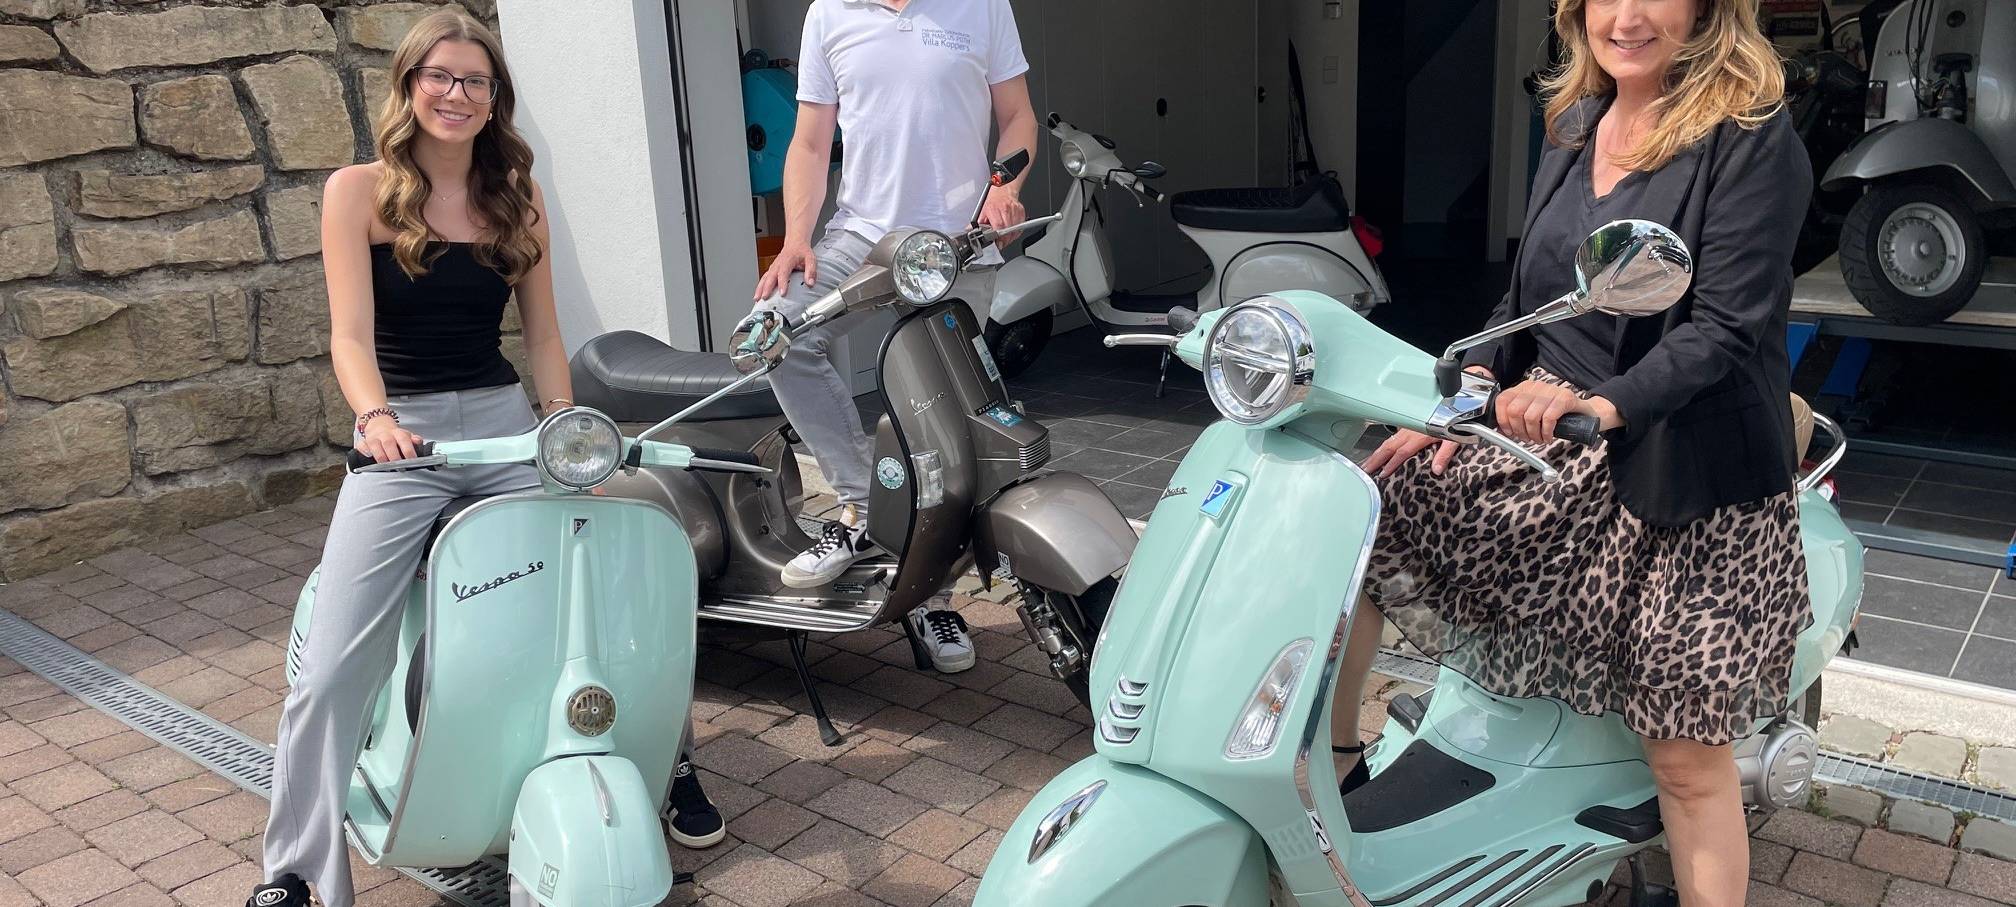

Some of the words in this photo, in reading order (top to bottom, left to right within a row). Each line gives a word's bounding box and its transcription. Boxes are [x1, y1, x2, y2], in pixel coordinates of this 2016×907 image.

[922, 38, 940, 47] Villa
[941, 39, 970, 52] Koppers
[1207, 484, 1223, 501] P
[452, 571, 525, 603] Vespa
[527, 560, 545, 574] 50
[541, 865, 558, 887] NO
